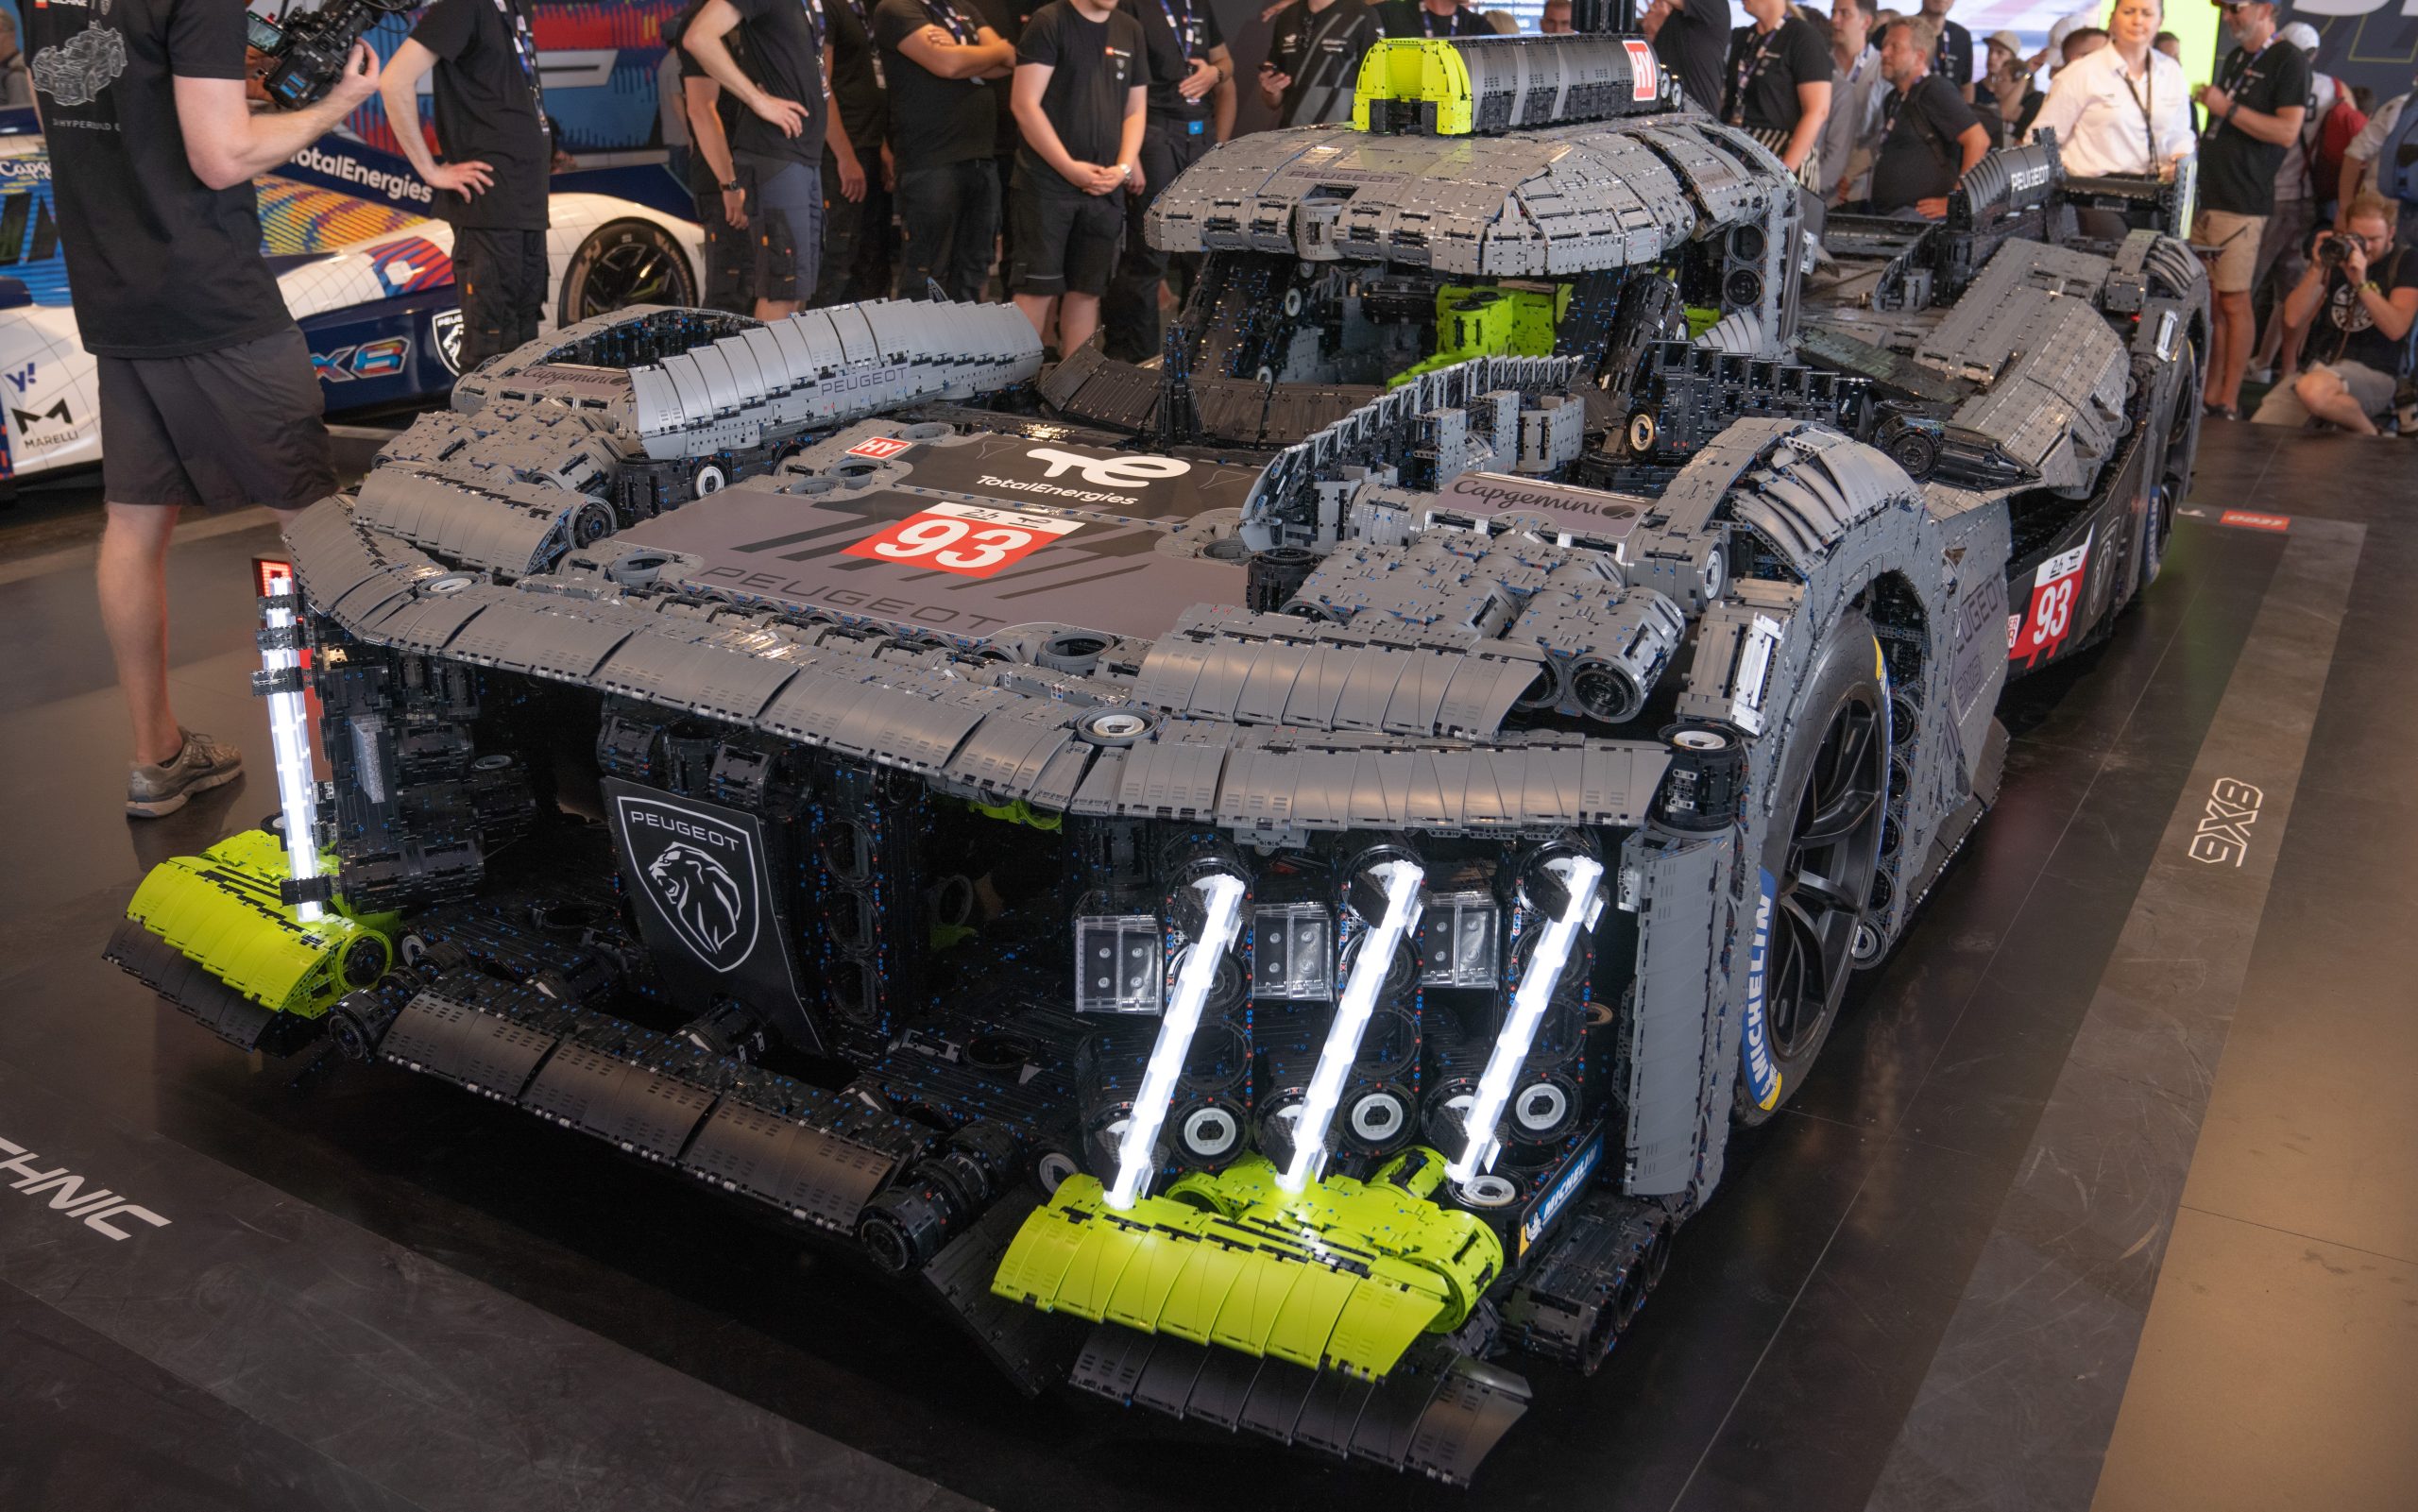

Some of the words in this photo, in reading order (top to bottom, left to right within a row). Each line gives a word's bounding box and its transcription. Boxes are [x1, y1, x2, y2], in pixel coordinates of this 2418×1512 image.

[1630, 51, 1652, 89] HY
[1288, 171, 1402, 184] PEUGEOT
[2011, 164, 2050, 193] PEUGEOT
[436, 314, 463, 328] PEUG
[310, 335, 412, 382] X8
[821, 366, 908, 396] PEUGEOT
[24, 430, 79, 450] MARELLI
[856, 439, 903, 455] HY
[975, 474, 1139, 505] TotalEnergies
[1453, 479, 1603, 516] Capgemini
[874, 518, 1032, 569] 93
[700, 566, 1008, 629] PEUGEOT
[1956, 571, 2004, 654] UGEOT
[2033, 579, 2073, 645] 93
[630, 810, 740, 851] PEUGEOT
[2188, 777, 2264, 867] 9X8
[1748, 893, 1772, 1084] MICHELIN
[1542, 1144, 1598, 1220] MICHELIN
